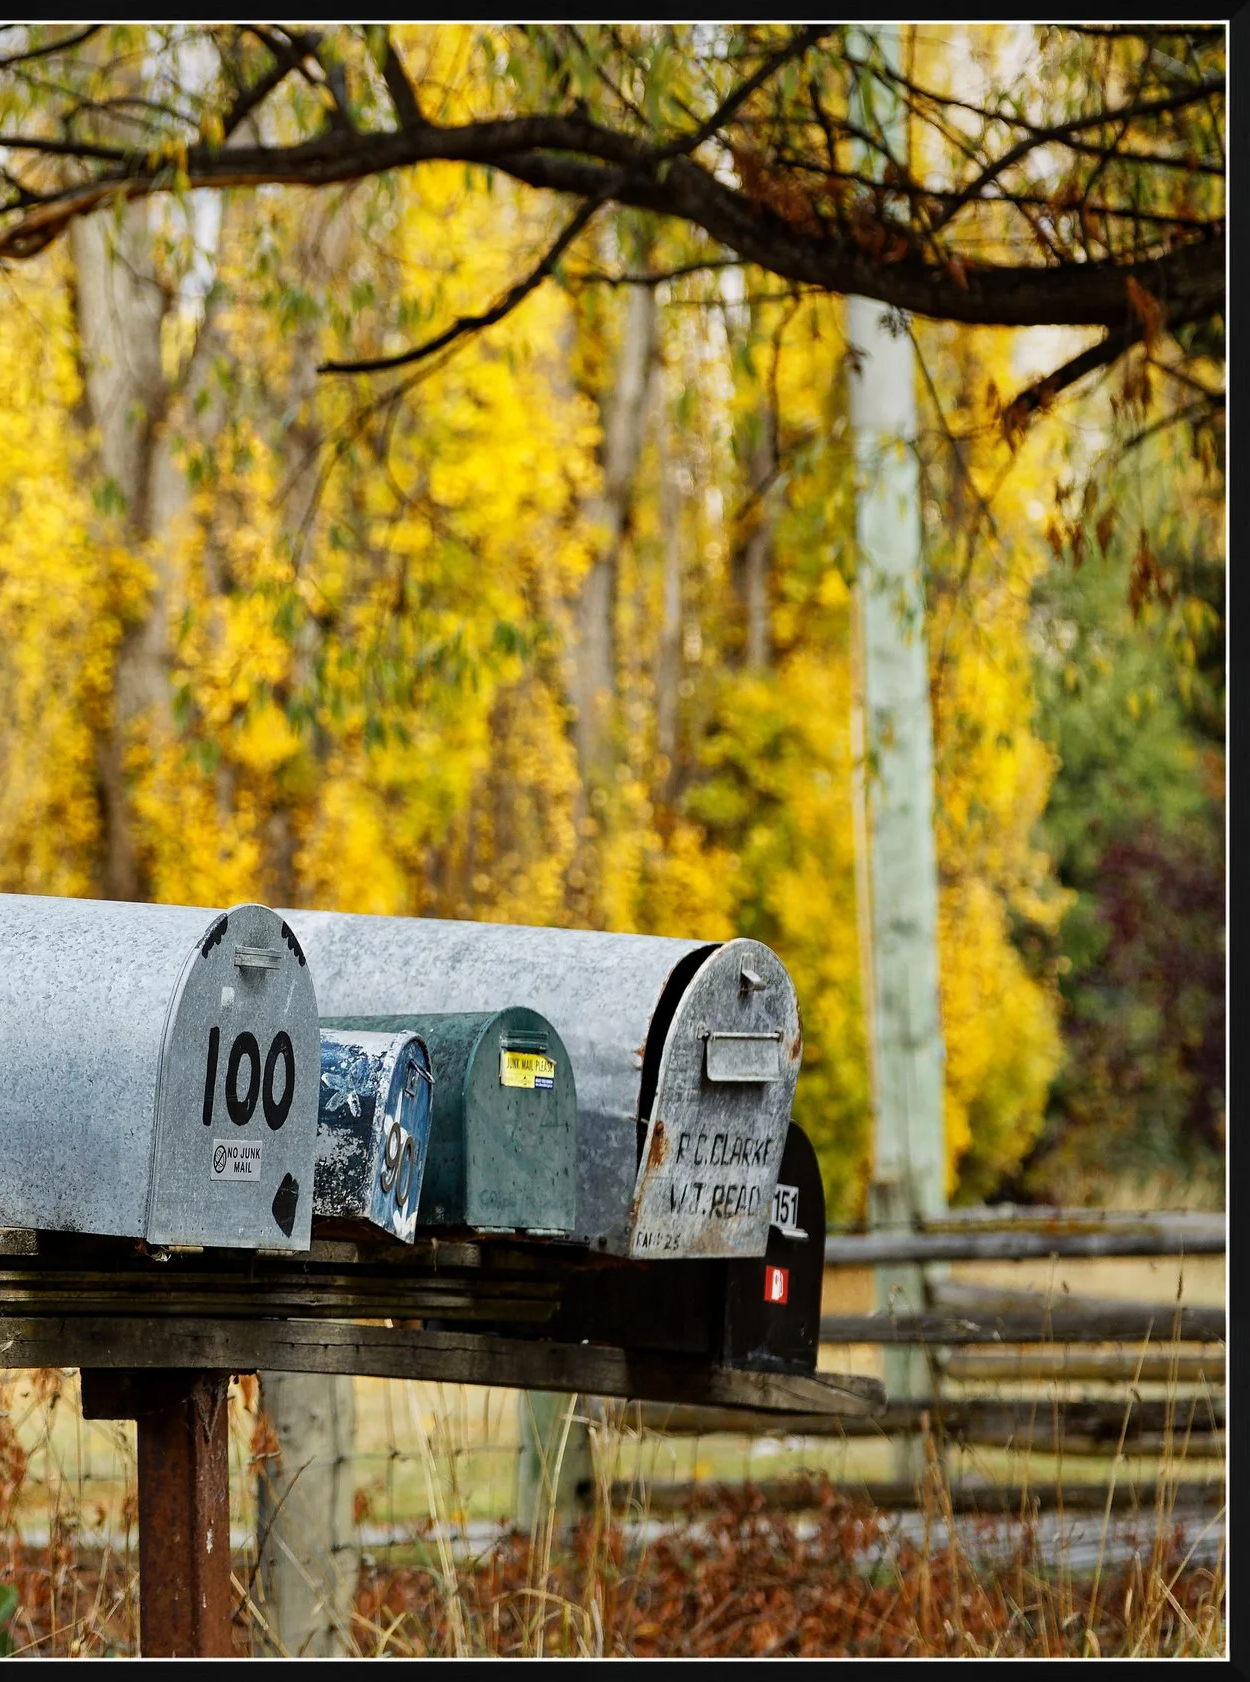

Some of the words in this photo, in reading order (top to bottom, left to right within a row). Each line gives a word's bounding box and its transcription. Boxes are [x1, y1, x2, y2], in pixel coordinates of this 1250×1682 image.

[521, 1059, 534, 1072] MAIL
[202, 1026, 295, 1131] 100
[227, 1146, 238, 1159] NO
[240, 1147, 261, 1160] JUNK
[381, 1122, 414, 1207] 90
[233, 1161, 252, 1174] MAIL
[774, 1189, 798, 1225] 151
